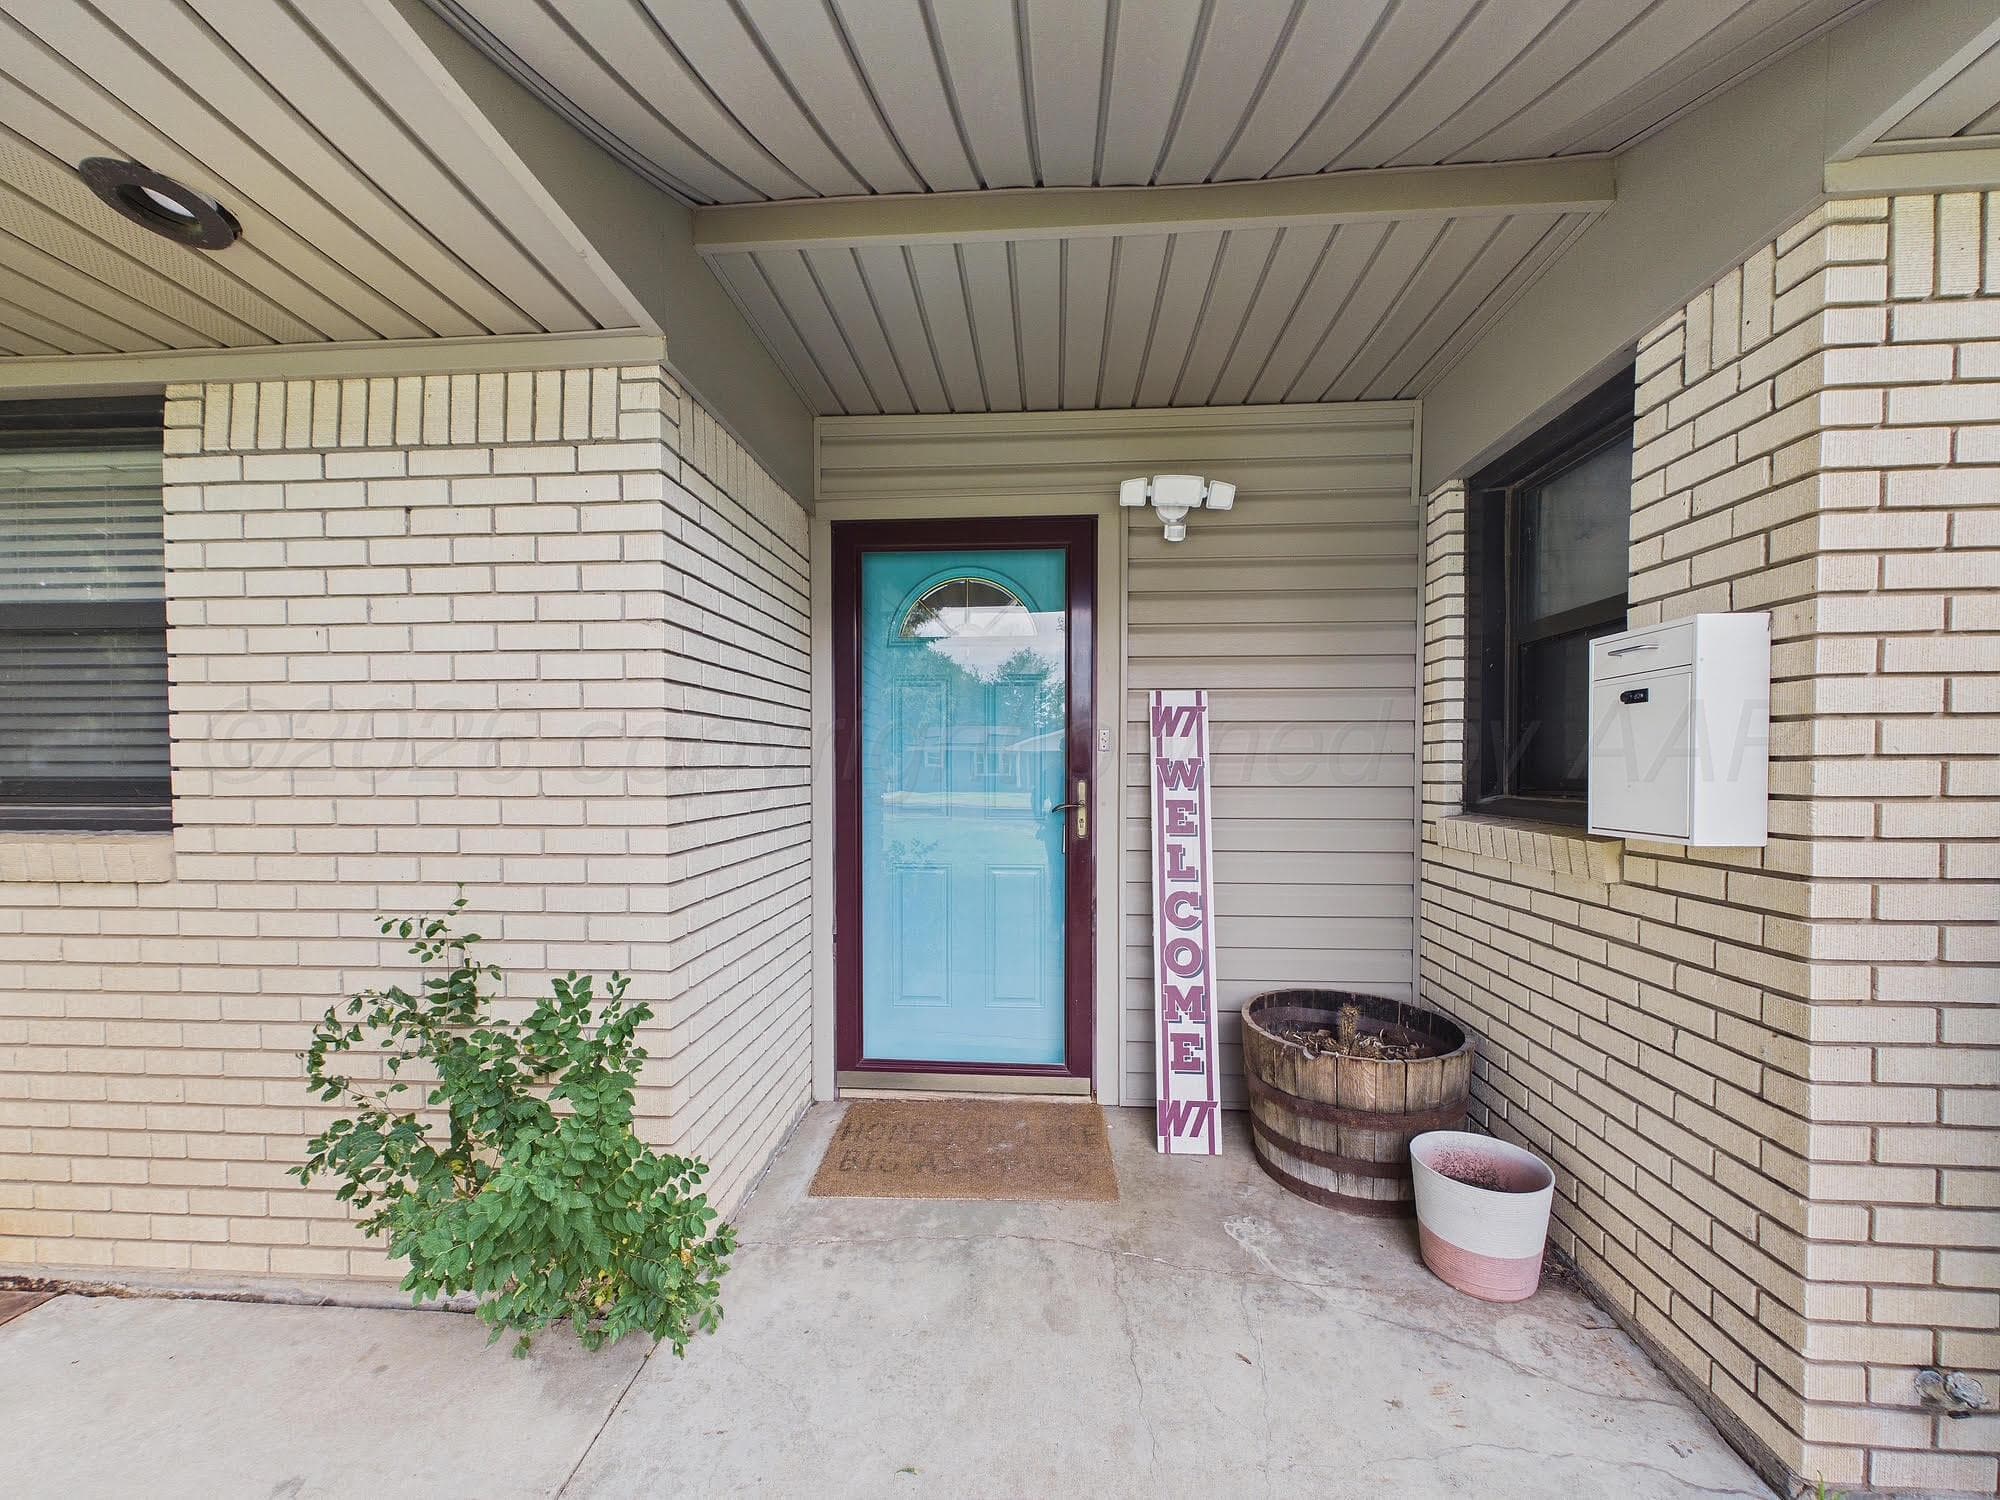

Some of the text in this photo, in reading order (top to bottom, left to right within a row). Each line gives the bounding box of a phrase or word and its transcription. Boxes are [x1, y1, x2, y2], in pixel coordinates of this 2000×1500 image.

[1152, 706, 1207, 737] WT
[1157, 758, 1206, 1075] WELCOME
[1158, 1099, 1217, 1137] WT
